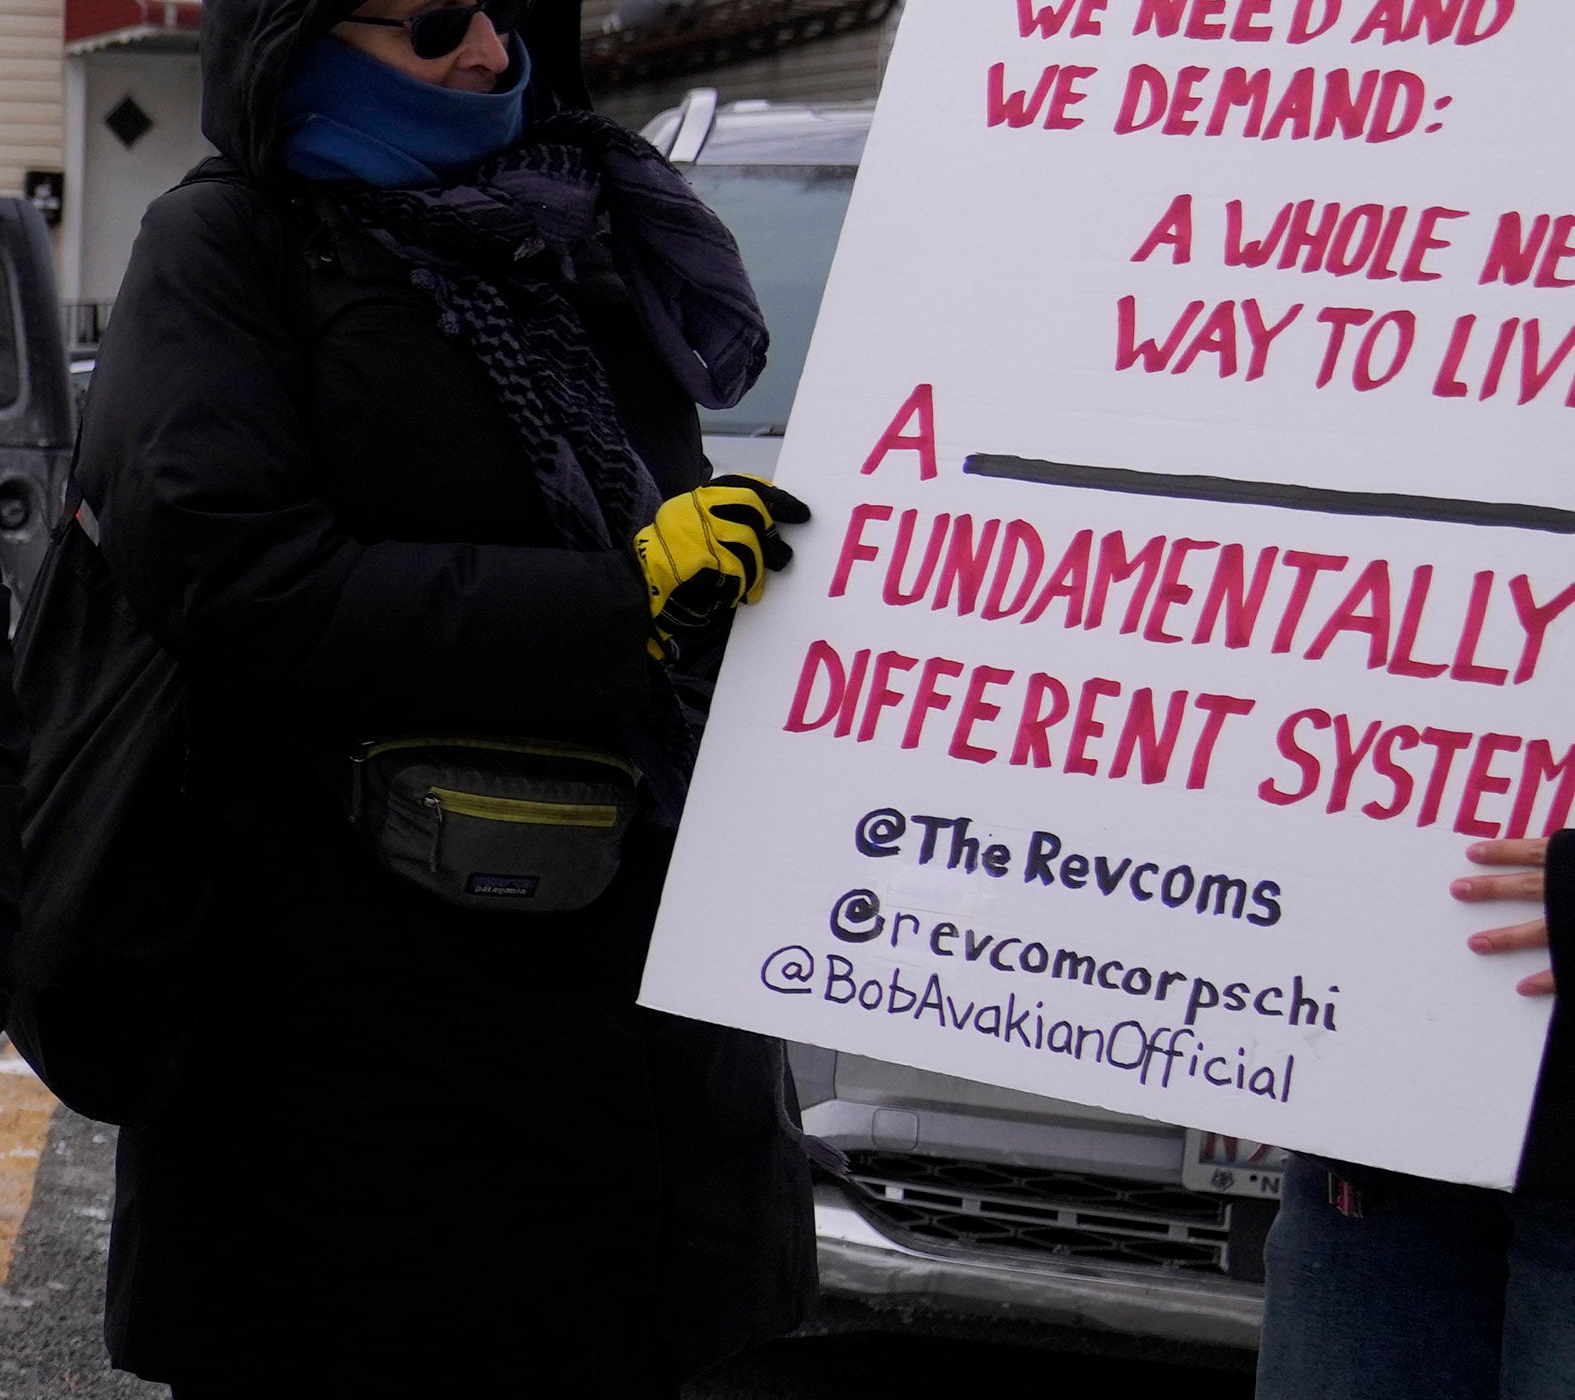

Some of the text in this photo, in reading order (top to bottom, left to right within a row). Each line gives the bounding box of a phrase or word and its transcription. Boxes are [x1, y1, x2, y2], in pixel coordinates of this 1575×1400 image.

[988, 63, 1452, 142] WE DEMAND:
[1132, 194, 1192, 264] A
[1225, 200, 1468, 281] WHOLE
[1116, 296, 1303, 379] WAY
[1317, 307, 1416, 391] TO
[861, 384, 937, 480] A
[827, 504, 1575, 686] FUNDAMENTALLY
[784, 640, 1575, 841] DIFFERENT SYSTEM
[830, 888, 1338, 1032] @revcomcorpschi
[761, 944, 1295, 1104] @BobAvakianOfficial
